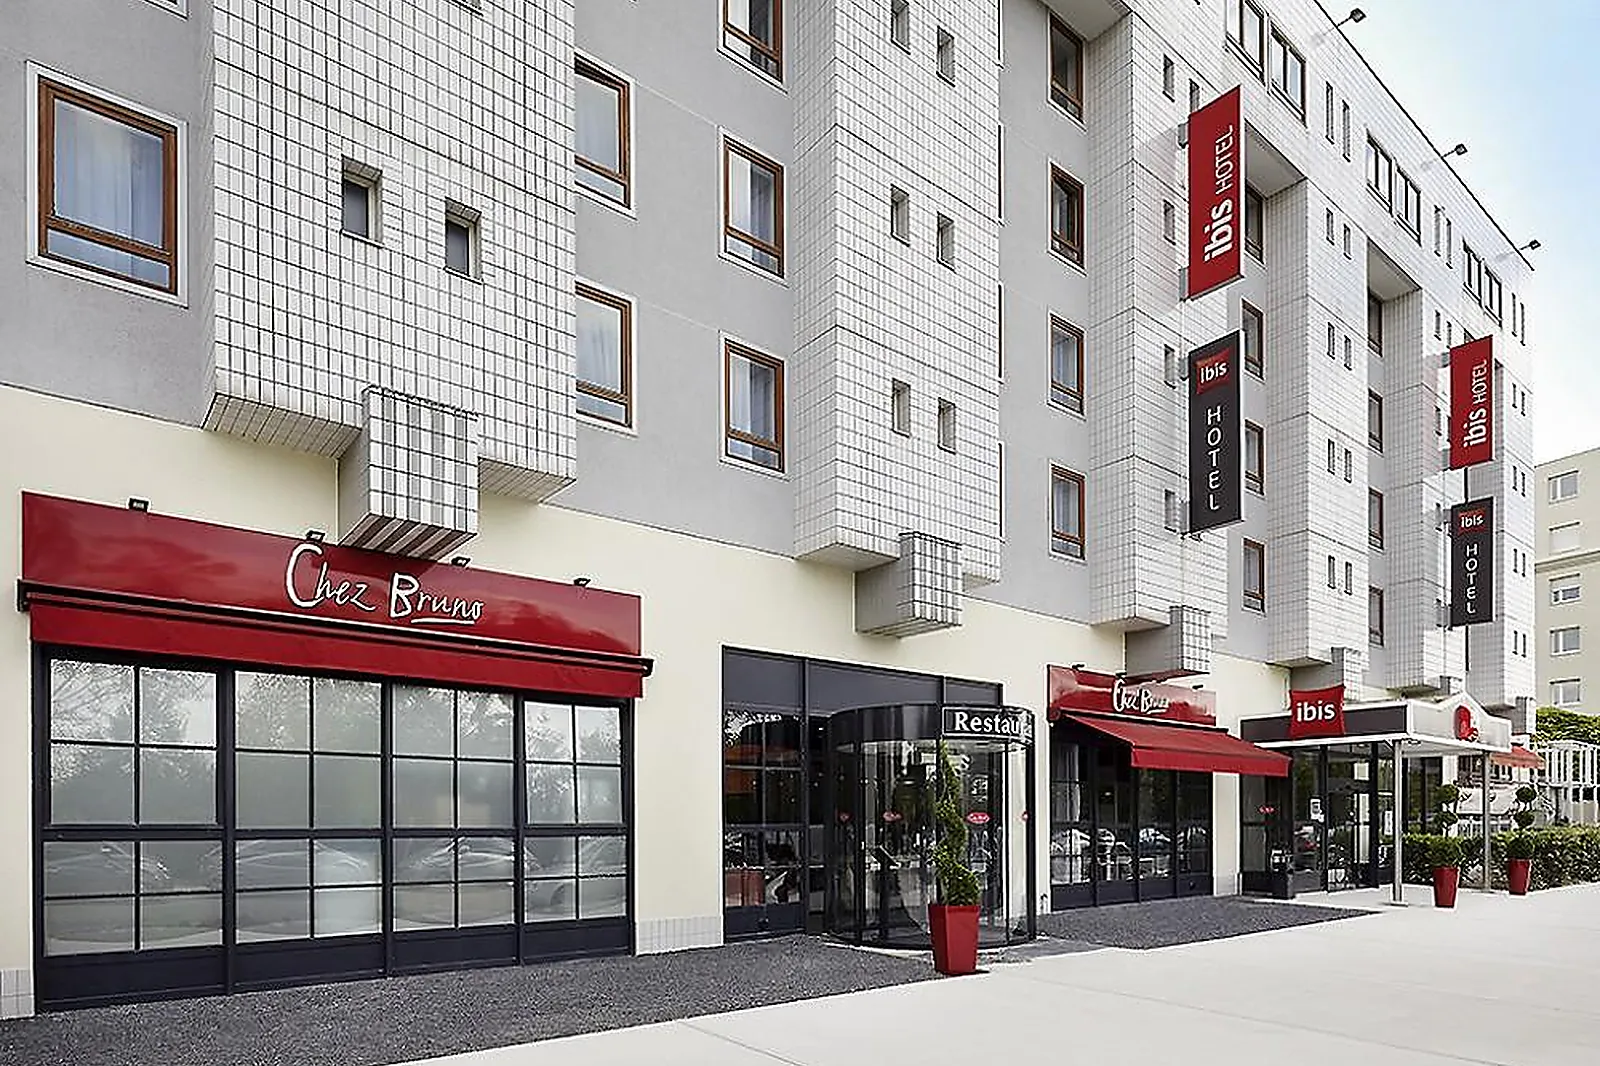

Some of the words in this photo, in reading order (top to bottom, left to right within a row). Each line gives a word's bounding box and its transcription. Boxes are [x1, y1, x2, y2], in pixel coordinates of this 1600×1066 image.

[1215, 124, 1233, 195] HOTEL
[1204, 198, 1233, 263] ibis
[1200, 361, 1228, 384] ibis
[1471, 359, 1487, 405] HOTEL
[1463, 408, 1487, 448] ibis
[1206, 405, 1222, 511] HOTEL
[1460, 514, 1484, 529] ibis
[285, 543, 376, 611] Chez
[389, 573, 485, 622] Bruno
[1465, 543, 1478, 614] HOTEL
[1296, 700, 1336, 722] ibis
